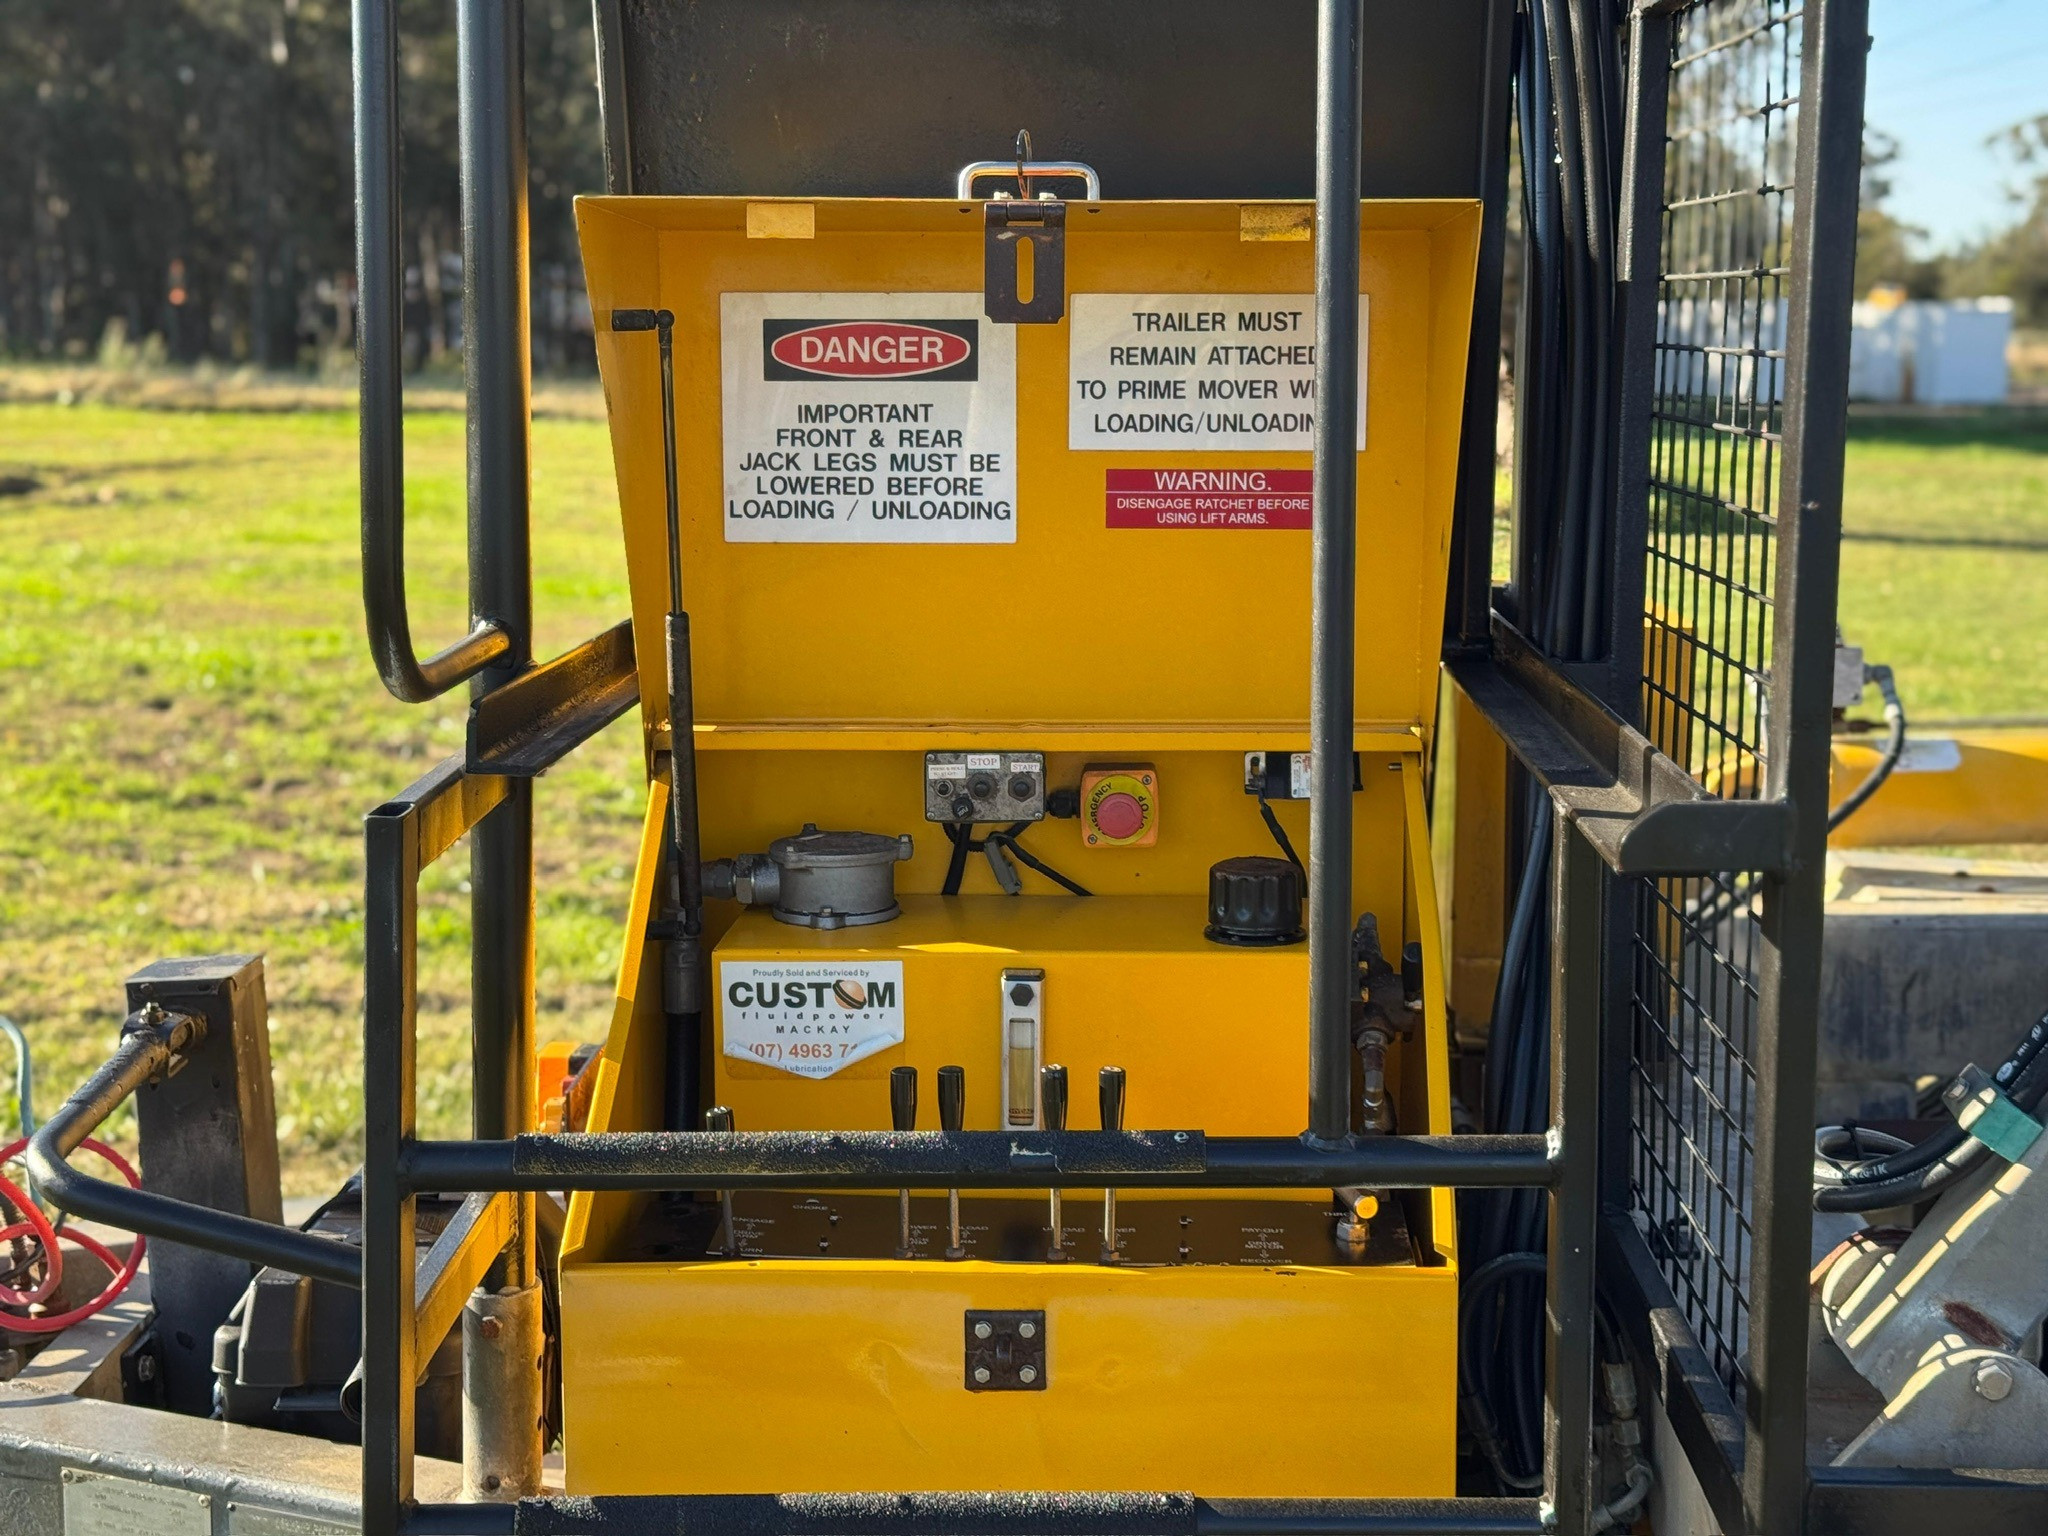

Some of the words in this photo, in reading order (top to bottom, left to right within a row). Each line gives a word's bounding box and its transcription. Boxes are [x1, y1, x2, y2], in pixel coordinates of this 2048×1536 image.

[1132, 312, 1226, 332] TRAILER
[1238, 311, 1302, 332] MUST
[800, 336, 944, 364] DANGER
[1110, 346, 1196, 366] REMAIN
[1077, 380, 1106, 400] TO
[1118, 380, 1186, 400] PRIME
[1198, 380, 1278, 399] MOVER
[797, 403, 934, 424] IMPORTANT
[1094, 411, 1315, 435] LOADING/UNLOADIN
[776, 428, 856, 448] FRONT
[869, 429, 885, 448] &
[899, 429, 963, 448] REAR
[739, 452, 802, 472] JACK
[814, 452, 877, 472] LEGS
[890, 453, 957, 472] MUST
[970, 453, 1001, 472] BE
[757, 476, 875, 496] LOWERED
[887, 476, 983, 496] BEFORE
[1154, 471, 1272, 491] WARNING.
[729, 499, 834, 519] LOADING
[872, 500, 1011, 520] UNLOADING
[1116, 498, 1192, 510] DISENGAGE
[1195, 498, 1253, 510] RATCHET
[1258, 499, 1310, 510] BEFORE
[1157, 512, 1197, 524] USING
[1200, 512, 1226, 524] LIFT
[1228, 513, 1269, 524] ARMS.
[970, 757, 998, 766] STOP
[1012, 763, 1039, 771] START
[753, 968, 784, 978] Proudly
[785, 969, 804, 977] Sold
[805, 969, 821, 977] and
[823, 969, 859, 977] Serviced
[860, 969, 870, 978] by
[728, 979, 896, 1010] CUSTOM
[741, 1011, 885, 1022] fluidpower
[776, 1025, 851, 1034] MACKAY
[788, 1043, 833, 1059] 4963
